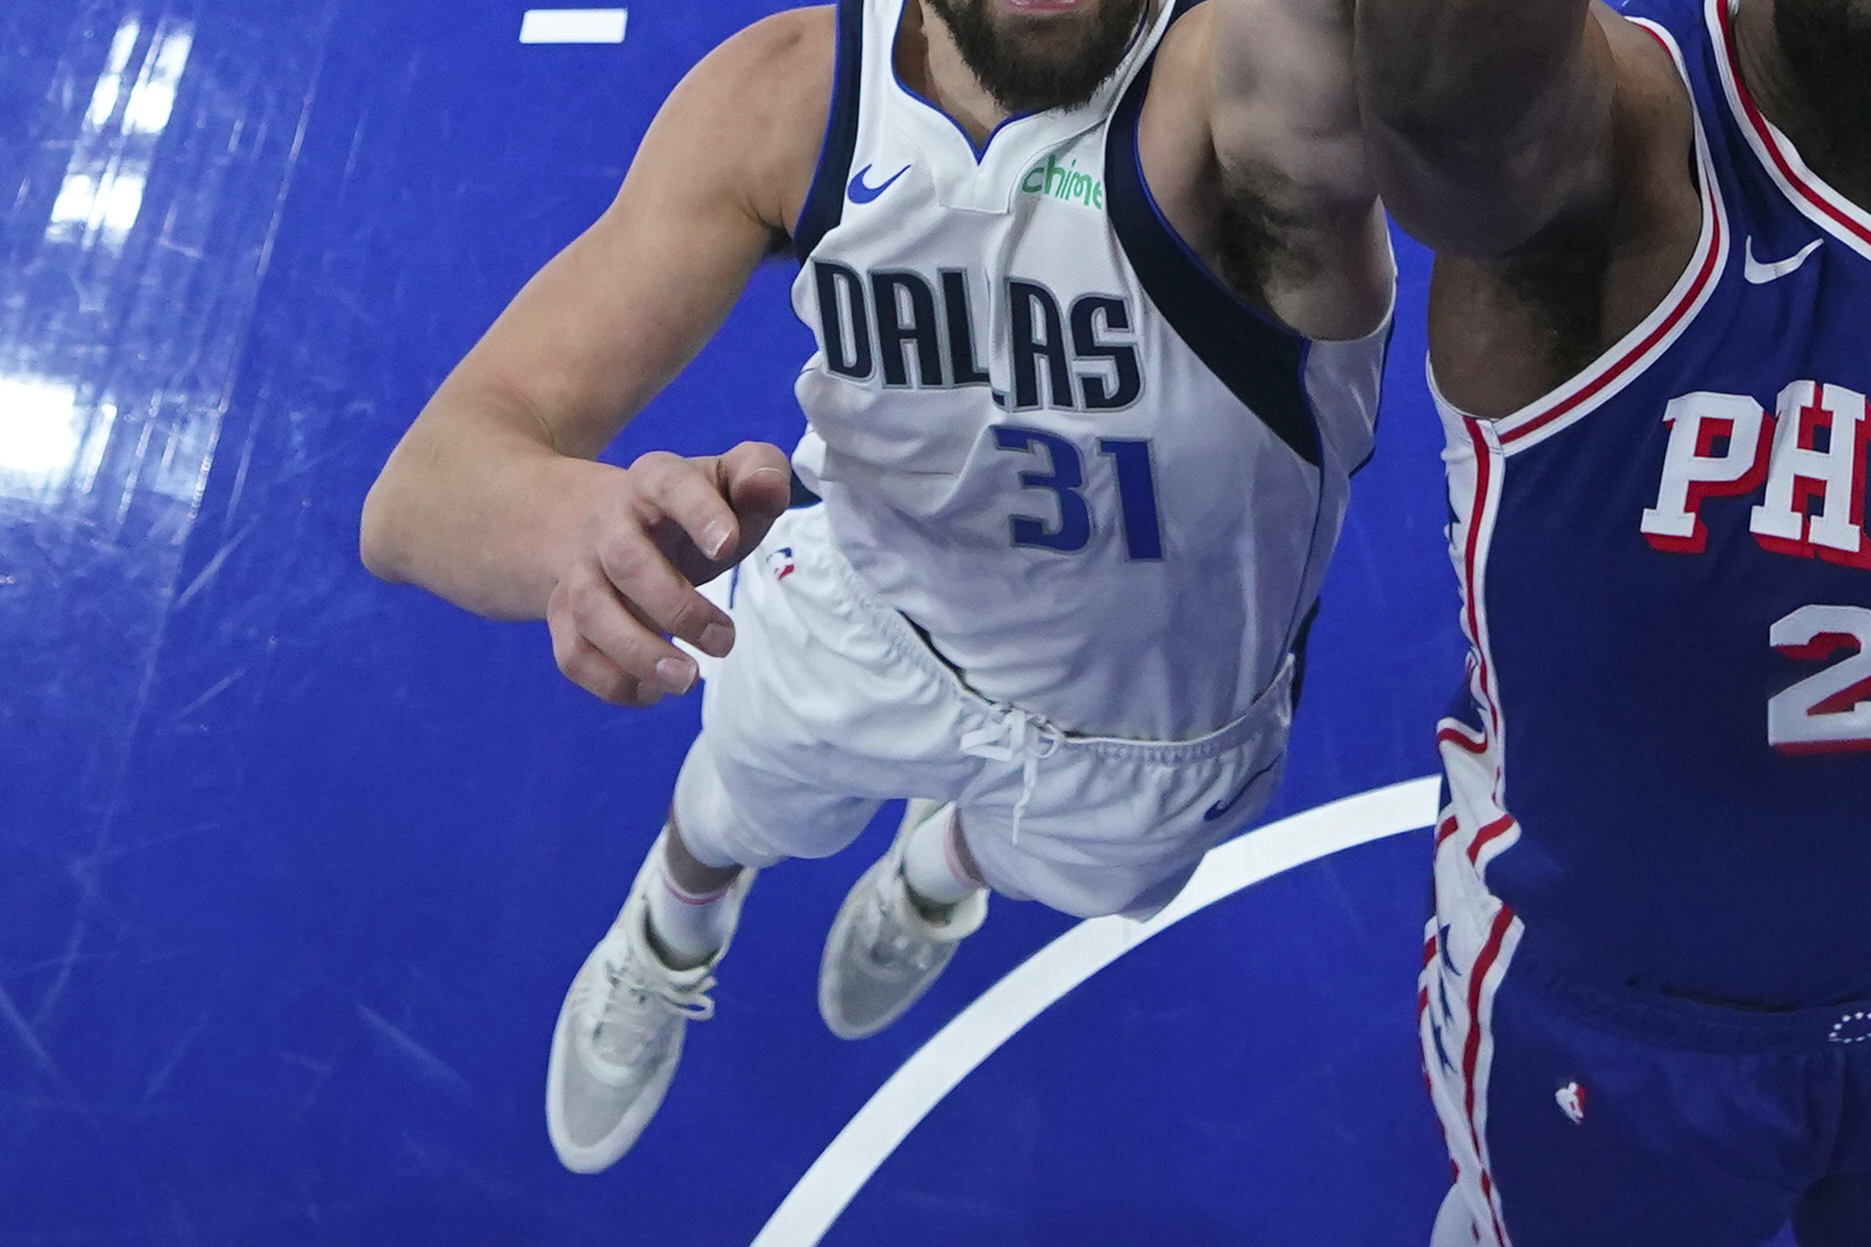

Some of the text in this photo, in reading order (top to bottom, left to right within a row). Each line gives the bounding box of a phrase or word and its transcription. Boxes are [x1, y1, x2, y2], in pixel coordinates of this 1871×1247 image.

[1022, 154, 1102, 210] chime
[810, 256, 1145, 413] DALAS
[988, 424, 1164, 562] 31
